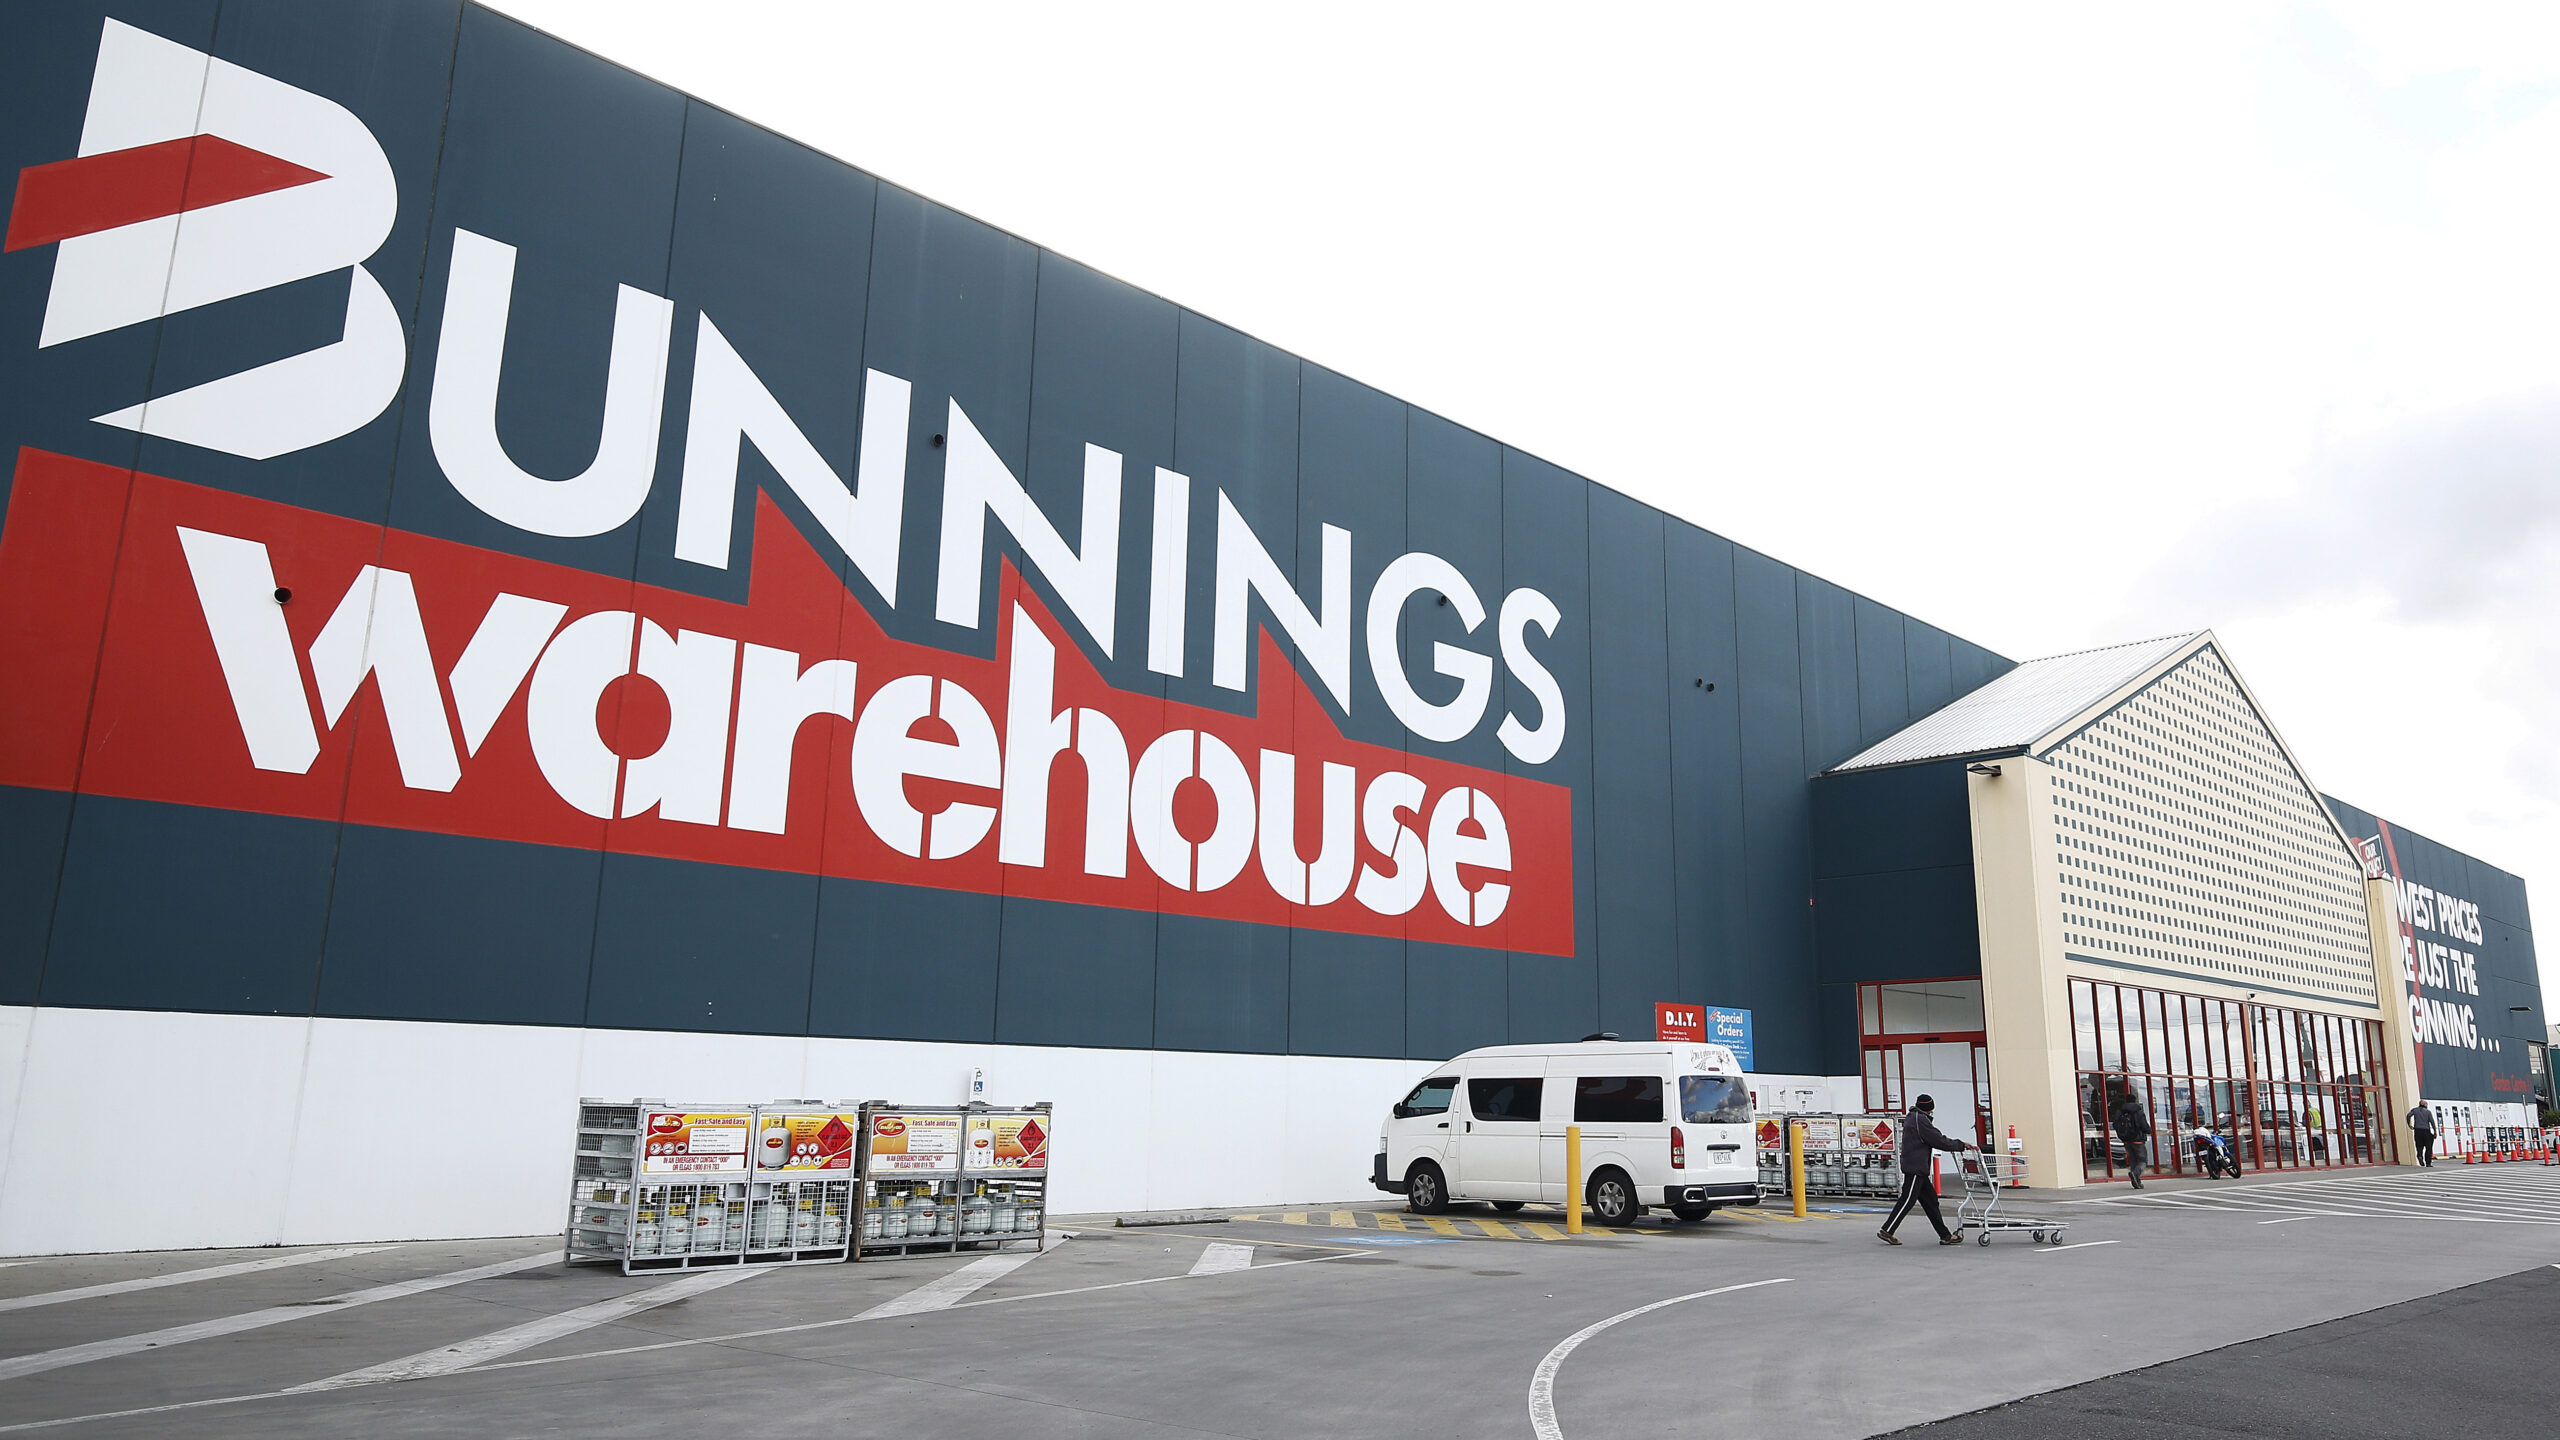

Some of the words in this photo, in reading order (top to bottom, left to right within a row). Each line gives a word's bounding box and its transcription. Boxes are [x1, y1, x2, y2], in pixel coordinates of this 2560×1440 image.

[38, 15, 1567, 765] BUNNINGS
[2383, 871, 2437, 932] WEST
[2436, 891, 2484, 947] PRICES
[2416, 939, 2451, 990] JUST
[2449, 947, 2480, 997] THE
[1665, 1010, 1698, 1028] D.I.Y.
[1716, 1011, 1744, 1026] Special
[1717, 1024, 1744, 1037] Orders
[2490, 1071, 2511, 1092] Garden
[708, 1117, 721, 1125] Safe
[721, 1117, 732, 1125] and
[733, 1117, 746, 1126] Easy
